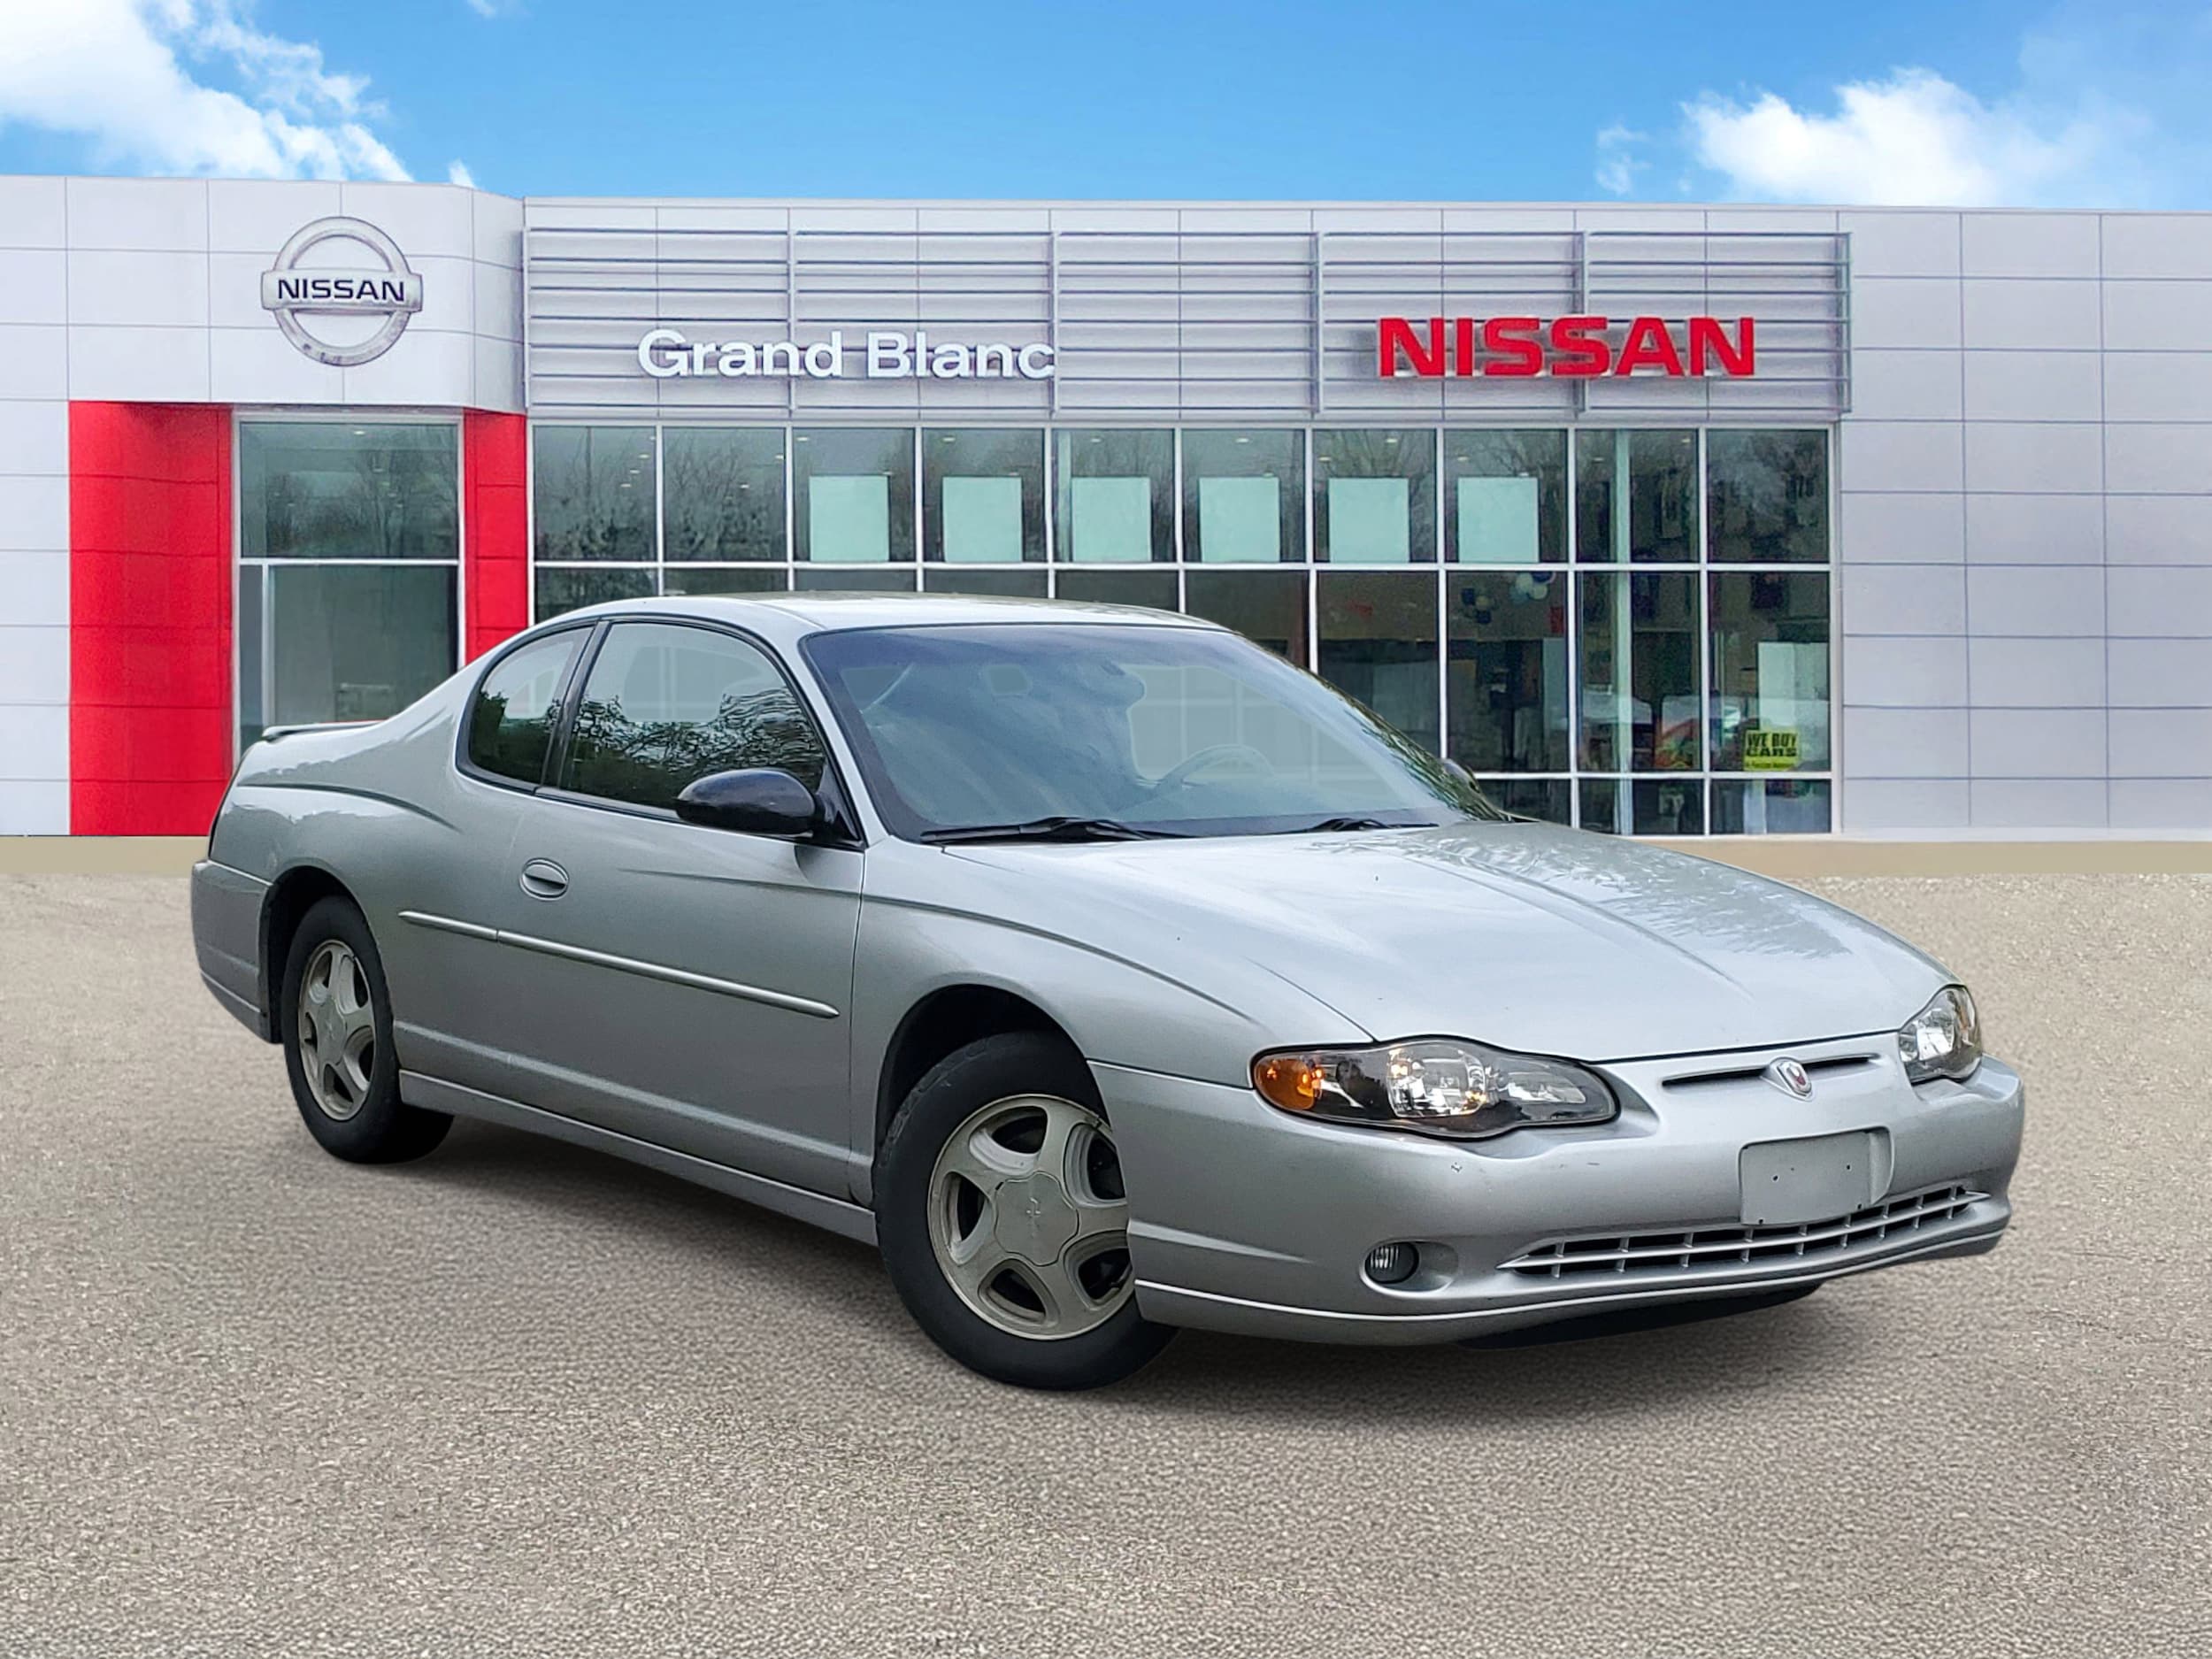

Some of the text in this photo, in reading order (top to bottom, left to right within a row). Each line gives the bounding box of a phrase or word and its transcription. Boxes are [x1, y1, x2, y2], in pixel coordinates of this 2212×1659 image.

[278, 279, 404, 302] NISSAN
[637, 328, 1056, 379] Grand Blanc
[1379, 316, 1755, 377] NISSAN
[1747, 732, 1797, 748] WE BUY
[1746, 748, 1797, 757] CARS
